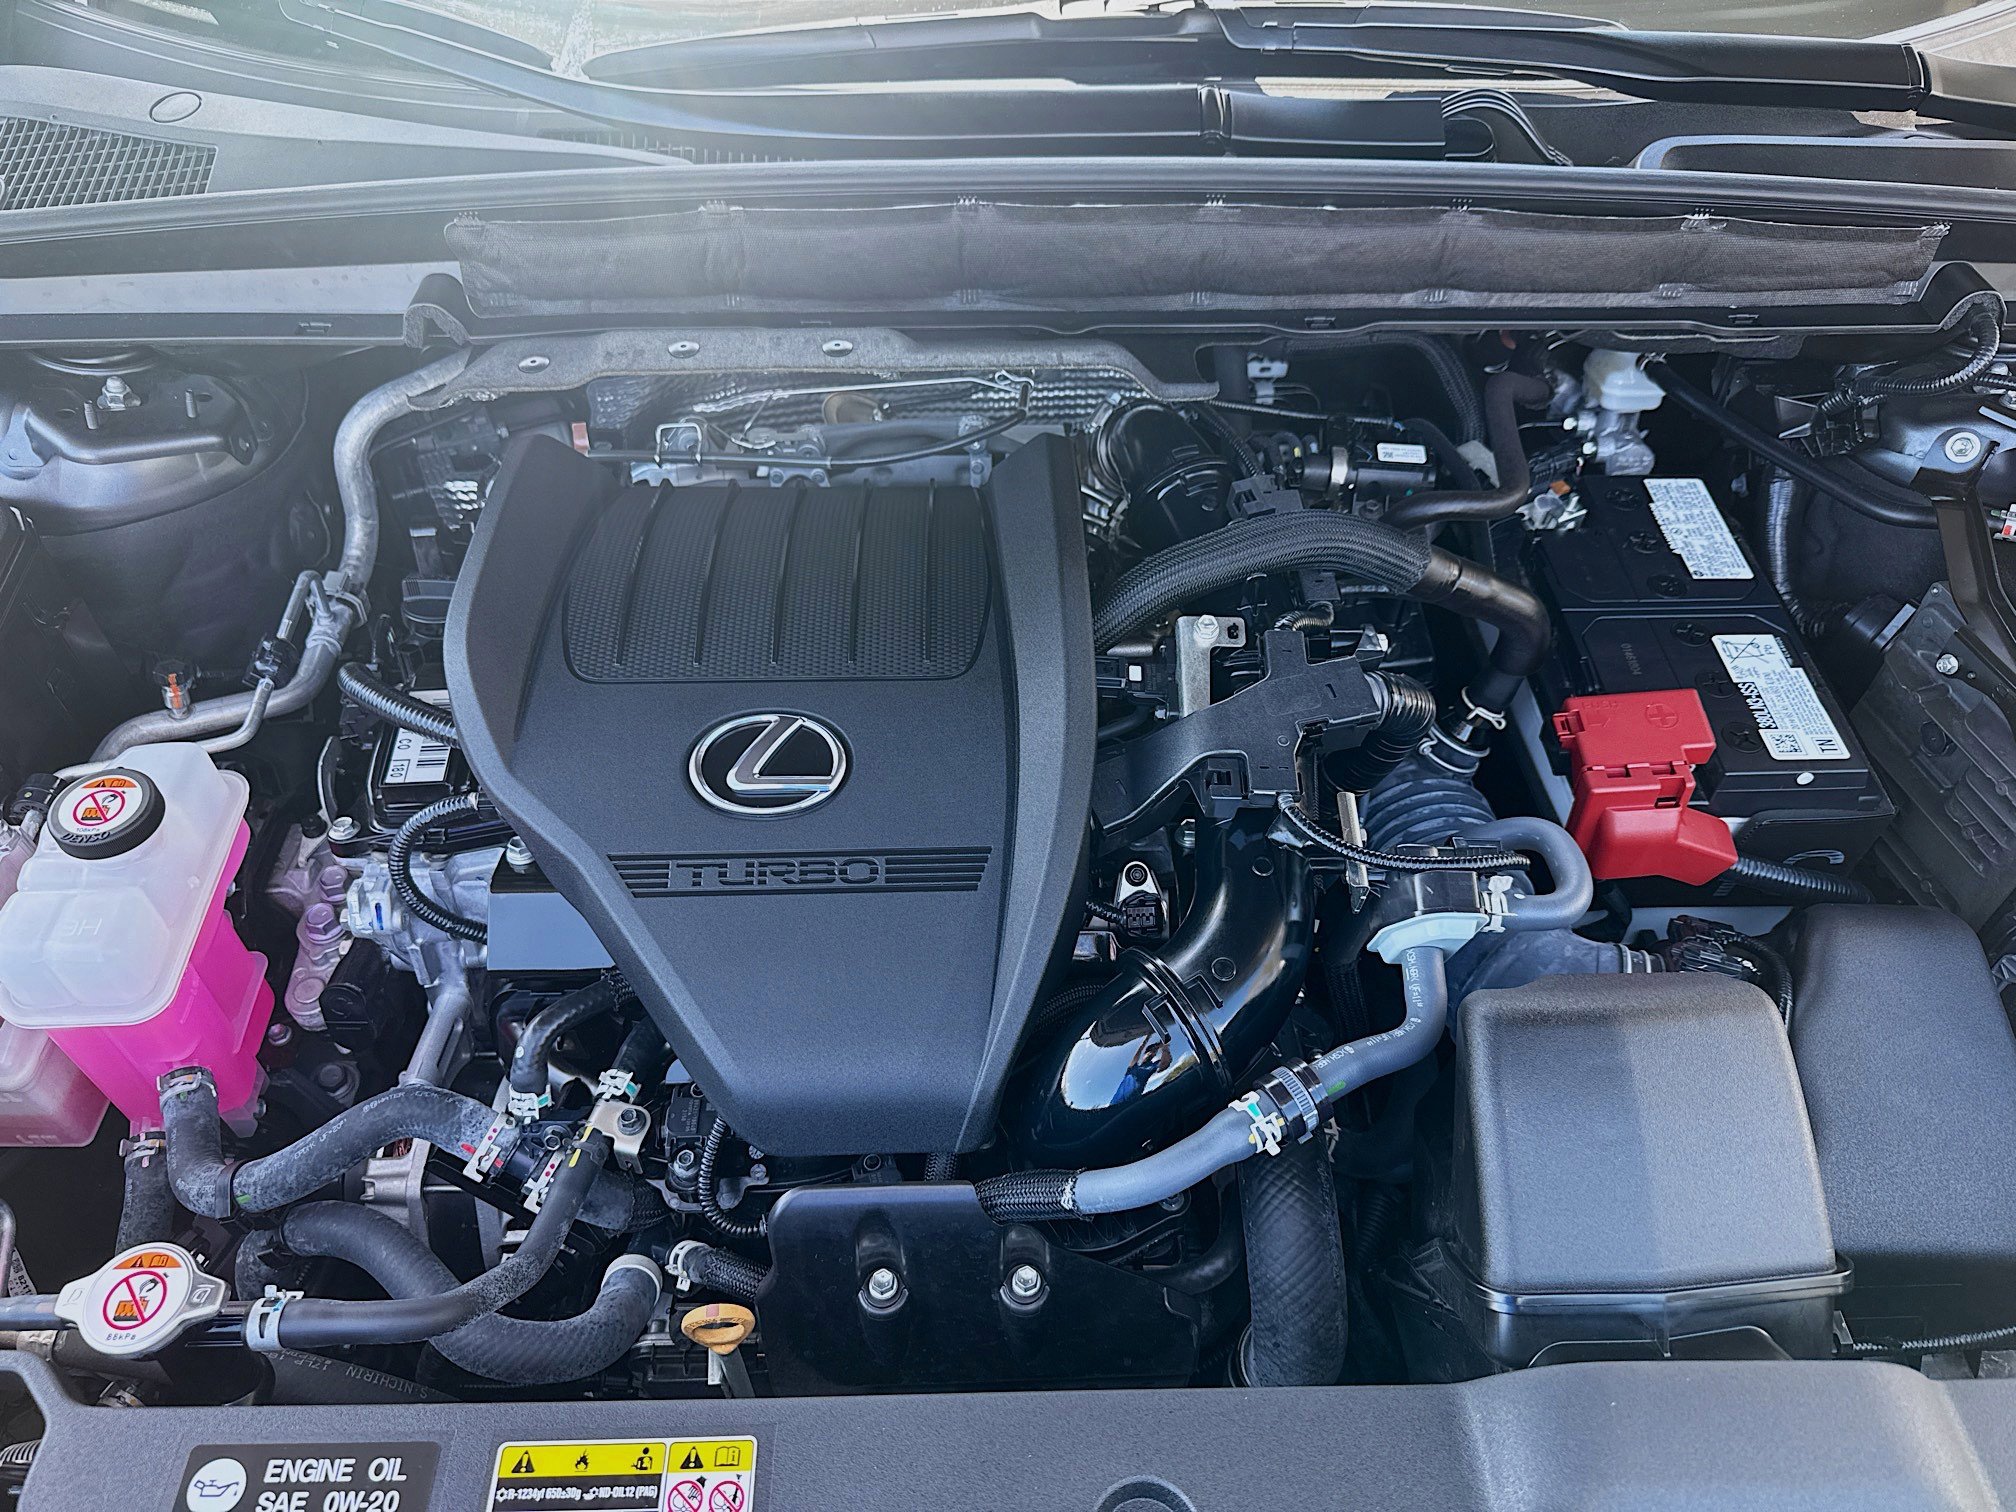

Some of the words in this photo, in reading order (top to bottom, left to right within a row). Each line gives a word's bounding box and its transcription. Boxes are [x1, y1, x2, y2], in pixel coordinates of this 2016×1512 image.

[1814, 738, 1839, 754] TN
[61, 831, 111, 844] DENSO
[676, 856, 880, 886] TURBO
[263, 1458, 356, 1483] ENGINE
[367, 1457, 408, 1482] OIL
[254, 1490, 310, 1512] SAE
[322, 1490, 400, 1512] 0W-20
